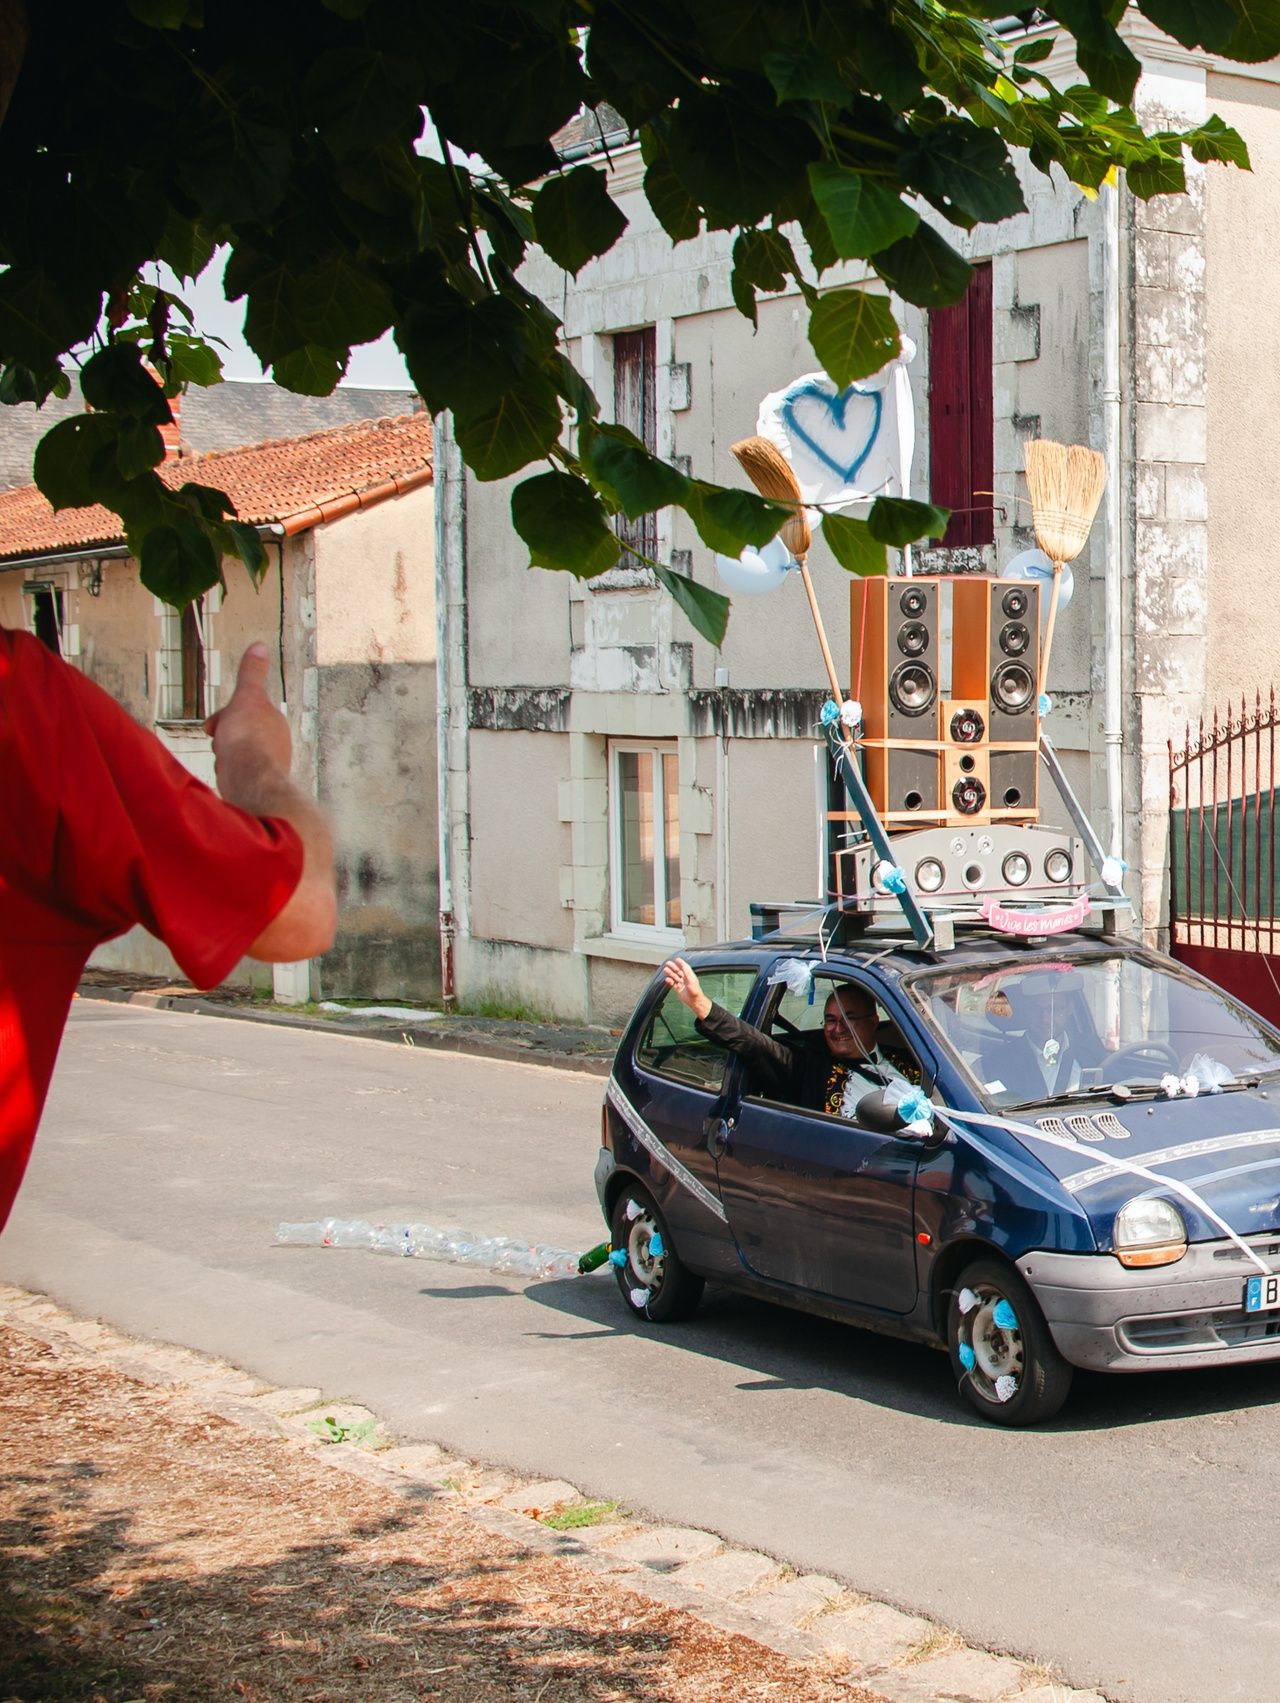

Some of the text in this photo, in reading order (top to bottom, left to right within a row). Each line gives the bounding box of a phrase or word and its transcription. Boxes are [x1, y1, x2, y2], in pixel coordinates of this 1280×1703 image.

[1000, 912, 1022, 931] Vive
[1023, 917, 1039, 932] les
[1251, 1297, 1258, 1306] F
